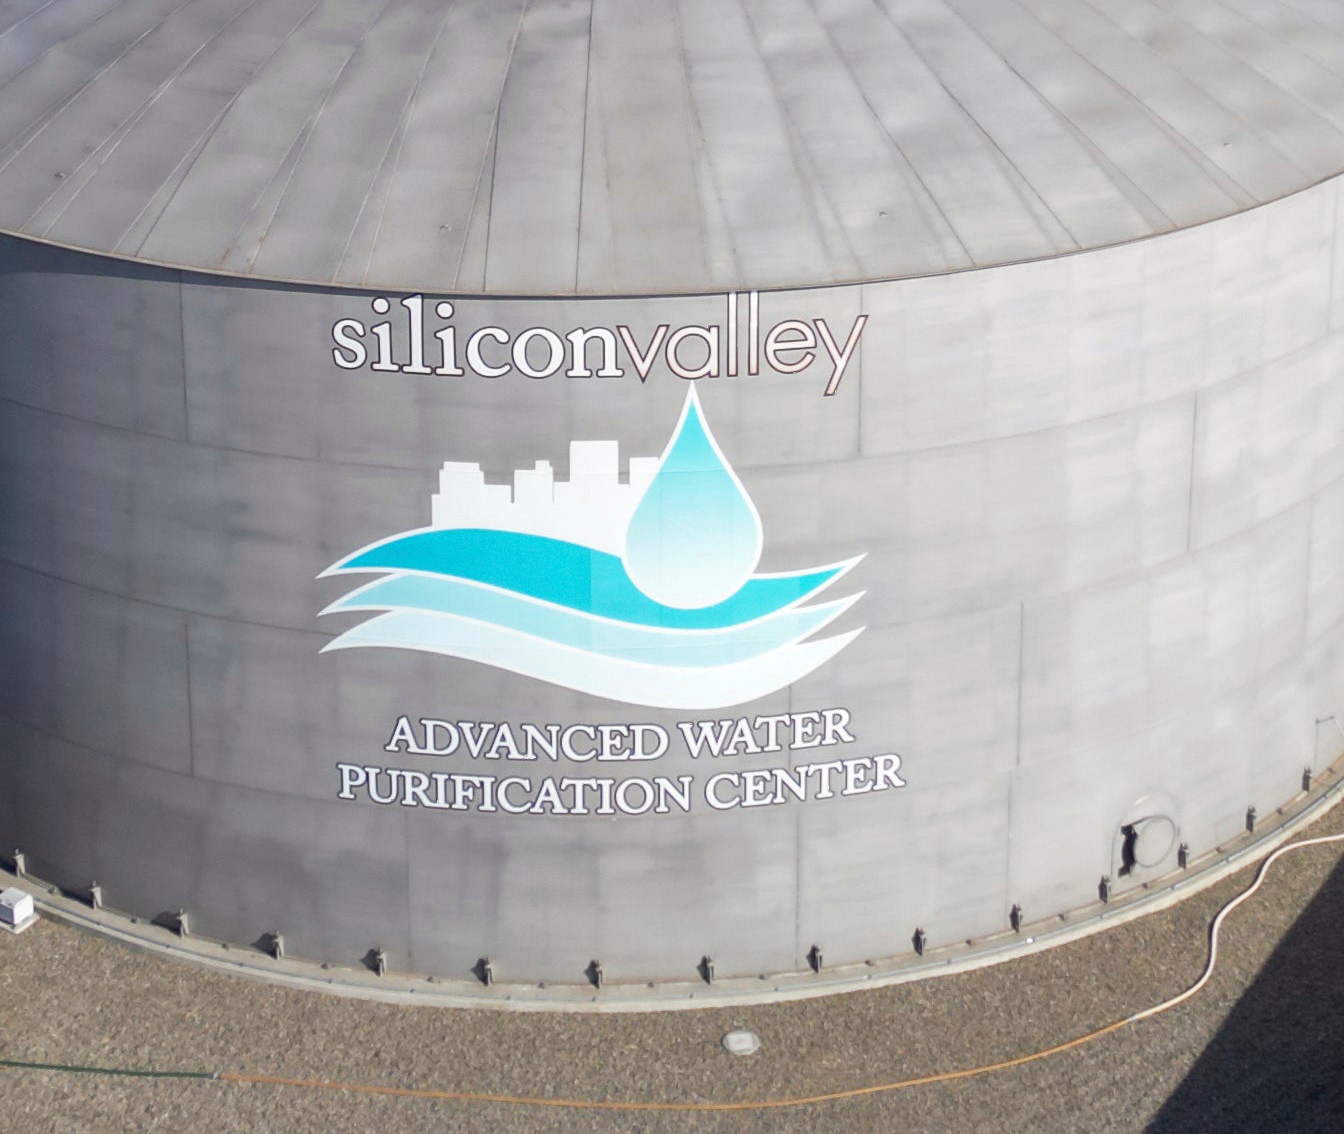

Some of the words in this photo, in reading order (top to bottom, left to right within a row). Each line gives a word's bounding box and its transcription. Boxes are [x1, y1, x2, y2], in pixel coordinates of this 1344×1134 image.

[384, 716, 669, 762] ADVANCED
[677, 707, 855, 759] WATER
[337, 764, 694, 815] PURIFICATION
[704, 753, 906, 811] CENTER
